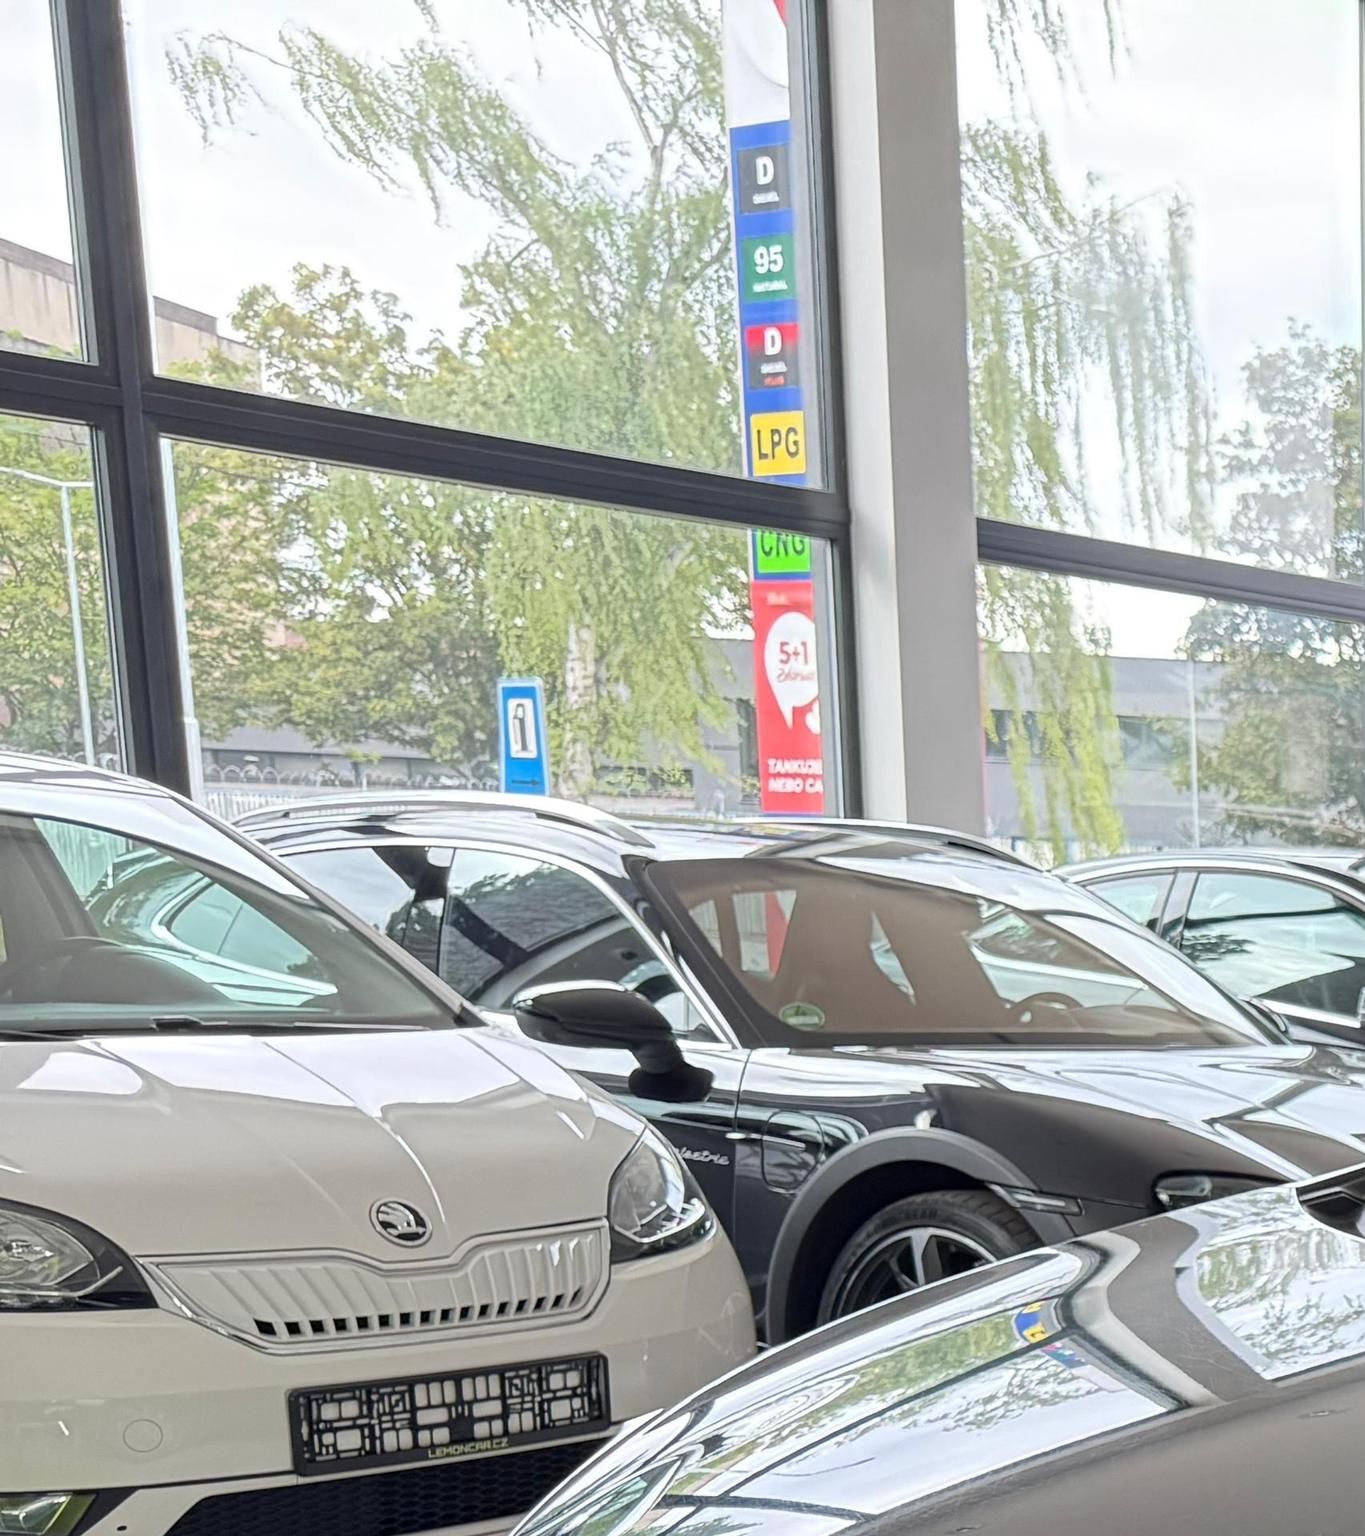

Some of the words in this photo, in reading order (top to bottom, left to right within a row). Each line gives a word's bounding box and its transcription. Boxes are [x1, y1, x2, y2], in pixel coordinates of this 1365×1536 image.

[756, 156, 775, 185] D
[753, 244, 784, 274] 95
[764, 326, 782, 355] D
[756, 426, 799, 461] LPG
[760, 528, 806, 558] CNG
[779, 641, 809, 665] 5+1
